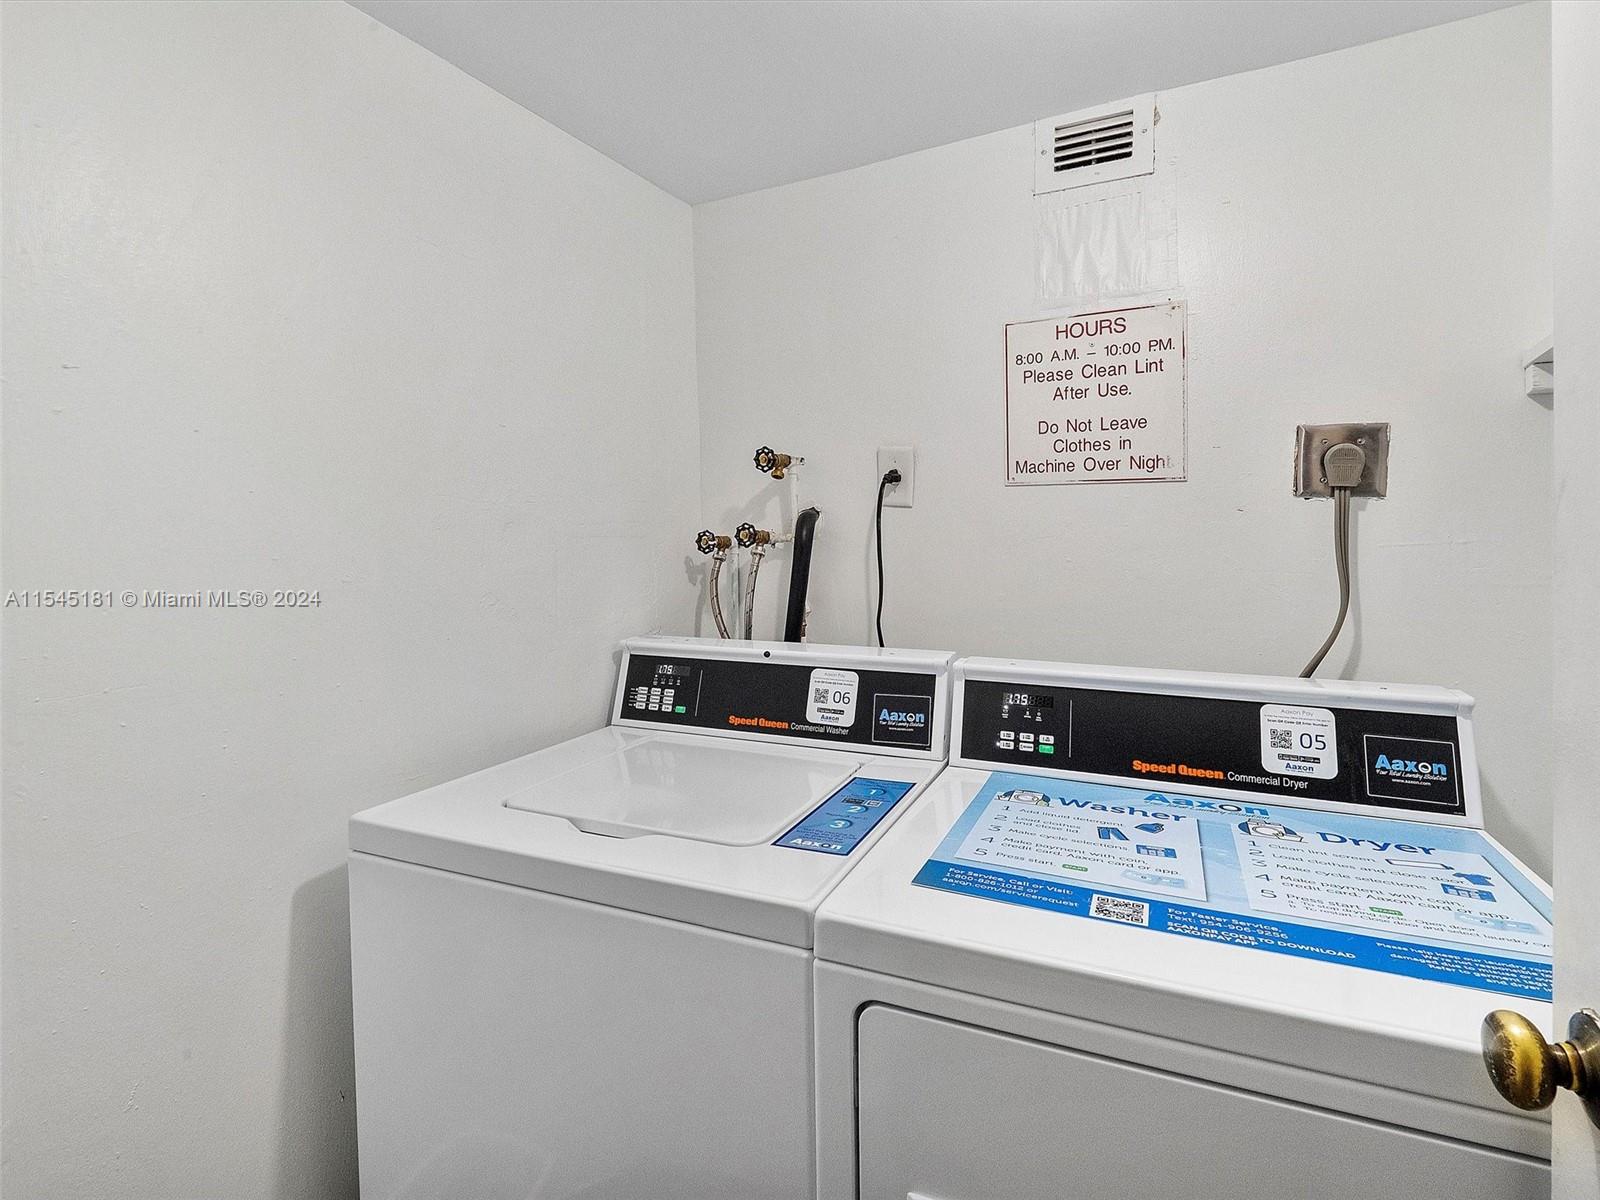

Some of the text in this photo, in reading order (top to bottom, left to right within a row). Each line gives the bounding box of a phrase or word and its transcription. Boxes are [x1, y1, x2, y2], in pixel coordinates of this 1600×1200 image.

[1055, 317, 1127, 340] HOURS
[1015, 352, 1043, 366] 8:00
[1050, 348, 1080, 362] A.M.
[1104, 341, 1141, 357] 10:00
[1023, 357, 1164, 384] Please Clean Lint
[1053, 382, 1132, 401] After Use.
[1038, 416, 1148, 435] Do Not Leave
[1052, 435, 1132, 454] Clothes in
[1015, 459, 1076, 474] Machine
[1083, 456, 1122, 472] Over
[832, 690, 851, 705] 06
[879, 708, 925, 723] Aaxon
[728, 715, 850, 737] Speed Queen Commercial Washer
[1299, 732, 1327, 751] 05
[1285, 761, 1315, 772] Aaxon
[1374, 753, 1448, 776] Aaxon
[1132, 759, 1309, 790] Speed Queen Commercial Dryer
[847, 805, 862, 814] 2
[1058, 797, 1186, 821] Washer
[1143, 792, 1270, 816] Aaxon
[829, 820, 846, 829] 3
[988, 824, 1002, 832] 3
[1008, 828, 1036, 836] Make
[1043, 821, 1081, 829] clothes
[789, 837, 843, 850] Aaxon
[1001, 843, 1032, 851] credit
[1066, 853, 1103, 863] Aaxon
[1003, 837, 1032, 845] Make
[1035, 843, 1085, 854] payment
[1089, 852, 1115, 860] with
[1268, 844, 1305, 853] Clean
[1317, 832, 1435, 855] Dryer
[974, 848, 988, 856] 5
[996, 852, 1025, 861] Press
[1249, 848, 1265, 857] 2
[1272, 853, 1304, 862] Load
[1307, 859, 1356, 870] clothes
[1390, 871, 1426, 879] close
[1251, 858, 1267, 867] 3
[1276, 864, 1311, 873] Make
[1315, 871, 1351, 879] cycle
[1009, 879, 1029, 887] Call
[1280, 875, 1316, 884] Make
[1320, 882, 1383, 895] payment
[1388, 892, 1423, 901] with
[1260, 889, 1277, 899] 5
[1286, 893, 1324, 904] Press
[1281, 882, 1321, 892] credit
[1366, 894, 1414, 906] Aaxon
[1418, 903, 1452, 911] card
[1191, 912, 1227, 922] Faster
[1167, 926, 1258, 946] AAXONPAY APP
[1200, 919, 1288, 939] 954-906-9256
[1167, 921, 1198, 932] SCAN
[1201, 927, 1219, 935] QR
[1222, 931, 1255, 942] CODE
[1277, 941, 1356, 959] DOWNLOAD
[1390, 953, 1439, 965] damaged
[1477, 968, 1517, 978] misuse
[1483, 959, 1530, 972] laundry
[1473, 972, 1521, 983] garment
